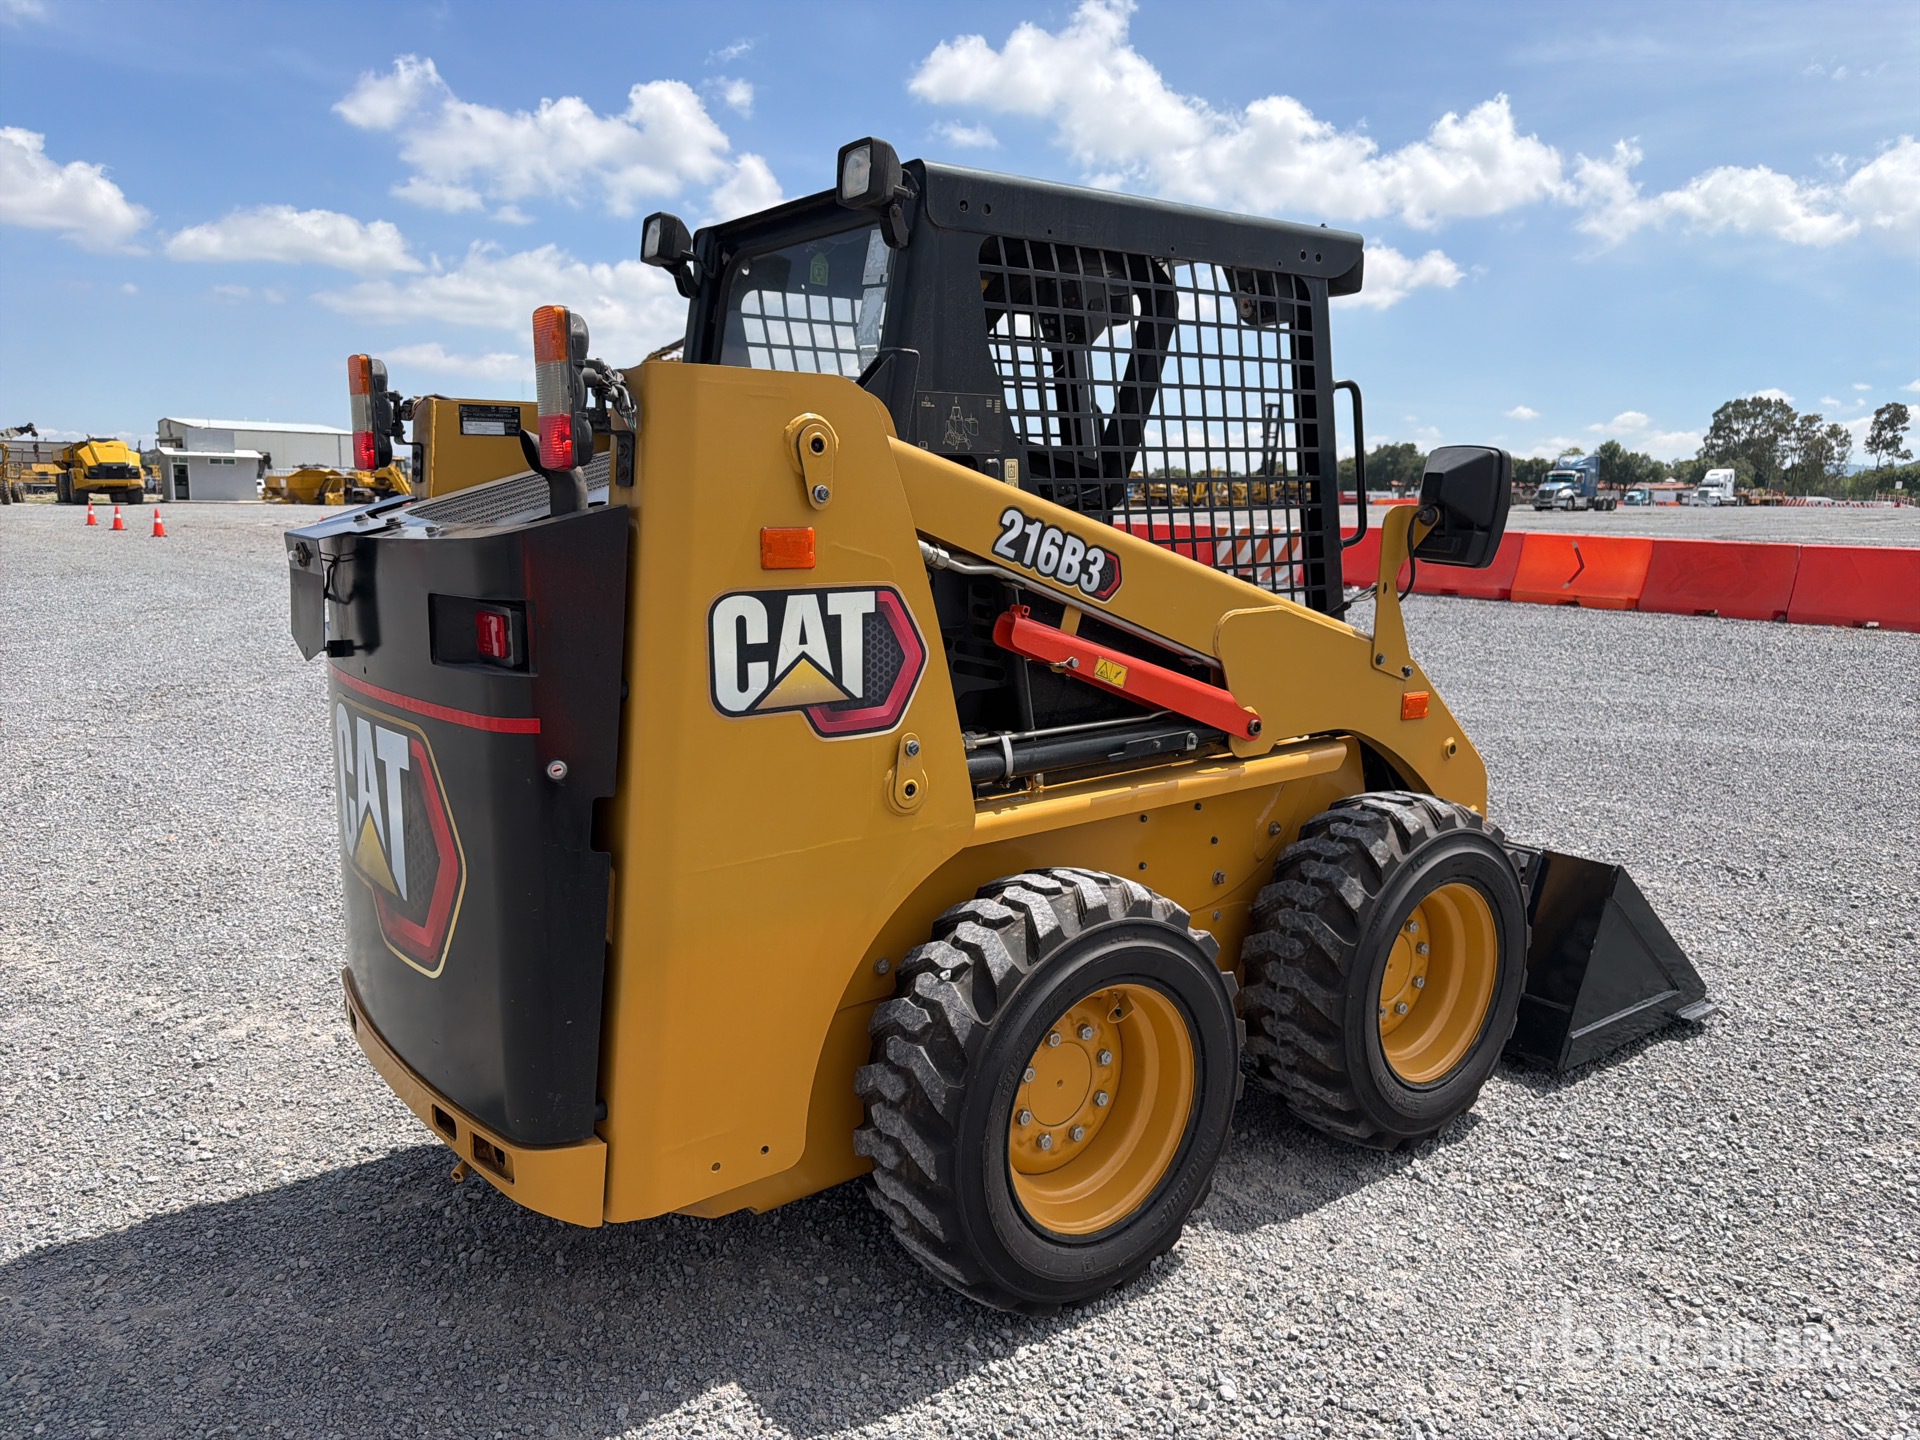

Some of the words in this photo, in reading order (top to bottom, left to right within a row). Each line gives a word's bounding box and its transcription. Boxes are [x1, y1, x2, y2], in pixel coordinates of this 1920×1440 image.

[994, 509, 1105, 593] 216B3
[712, 590, 876, 712] CAT
[336, 702, 410, 901] CAT
